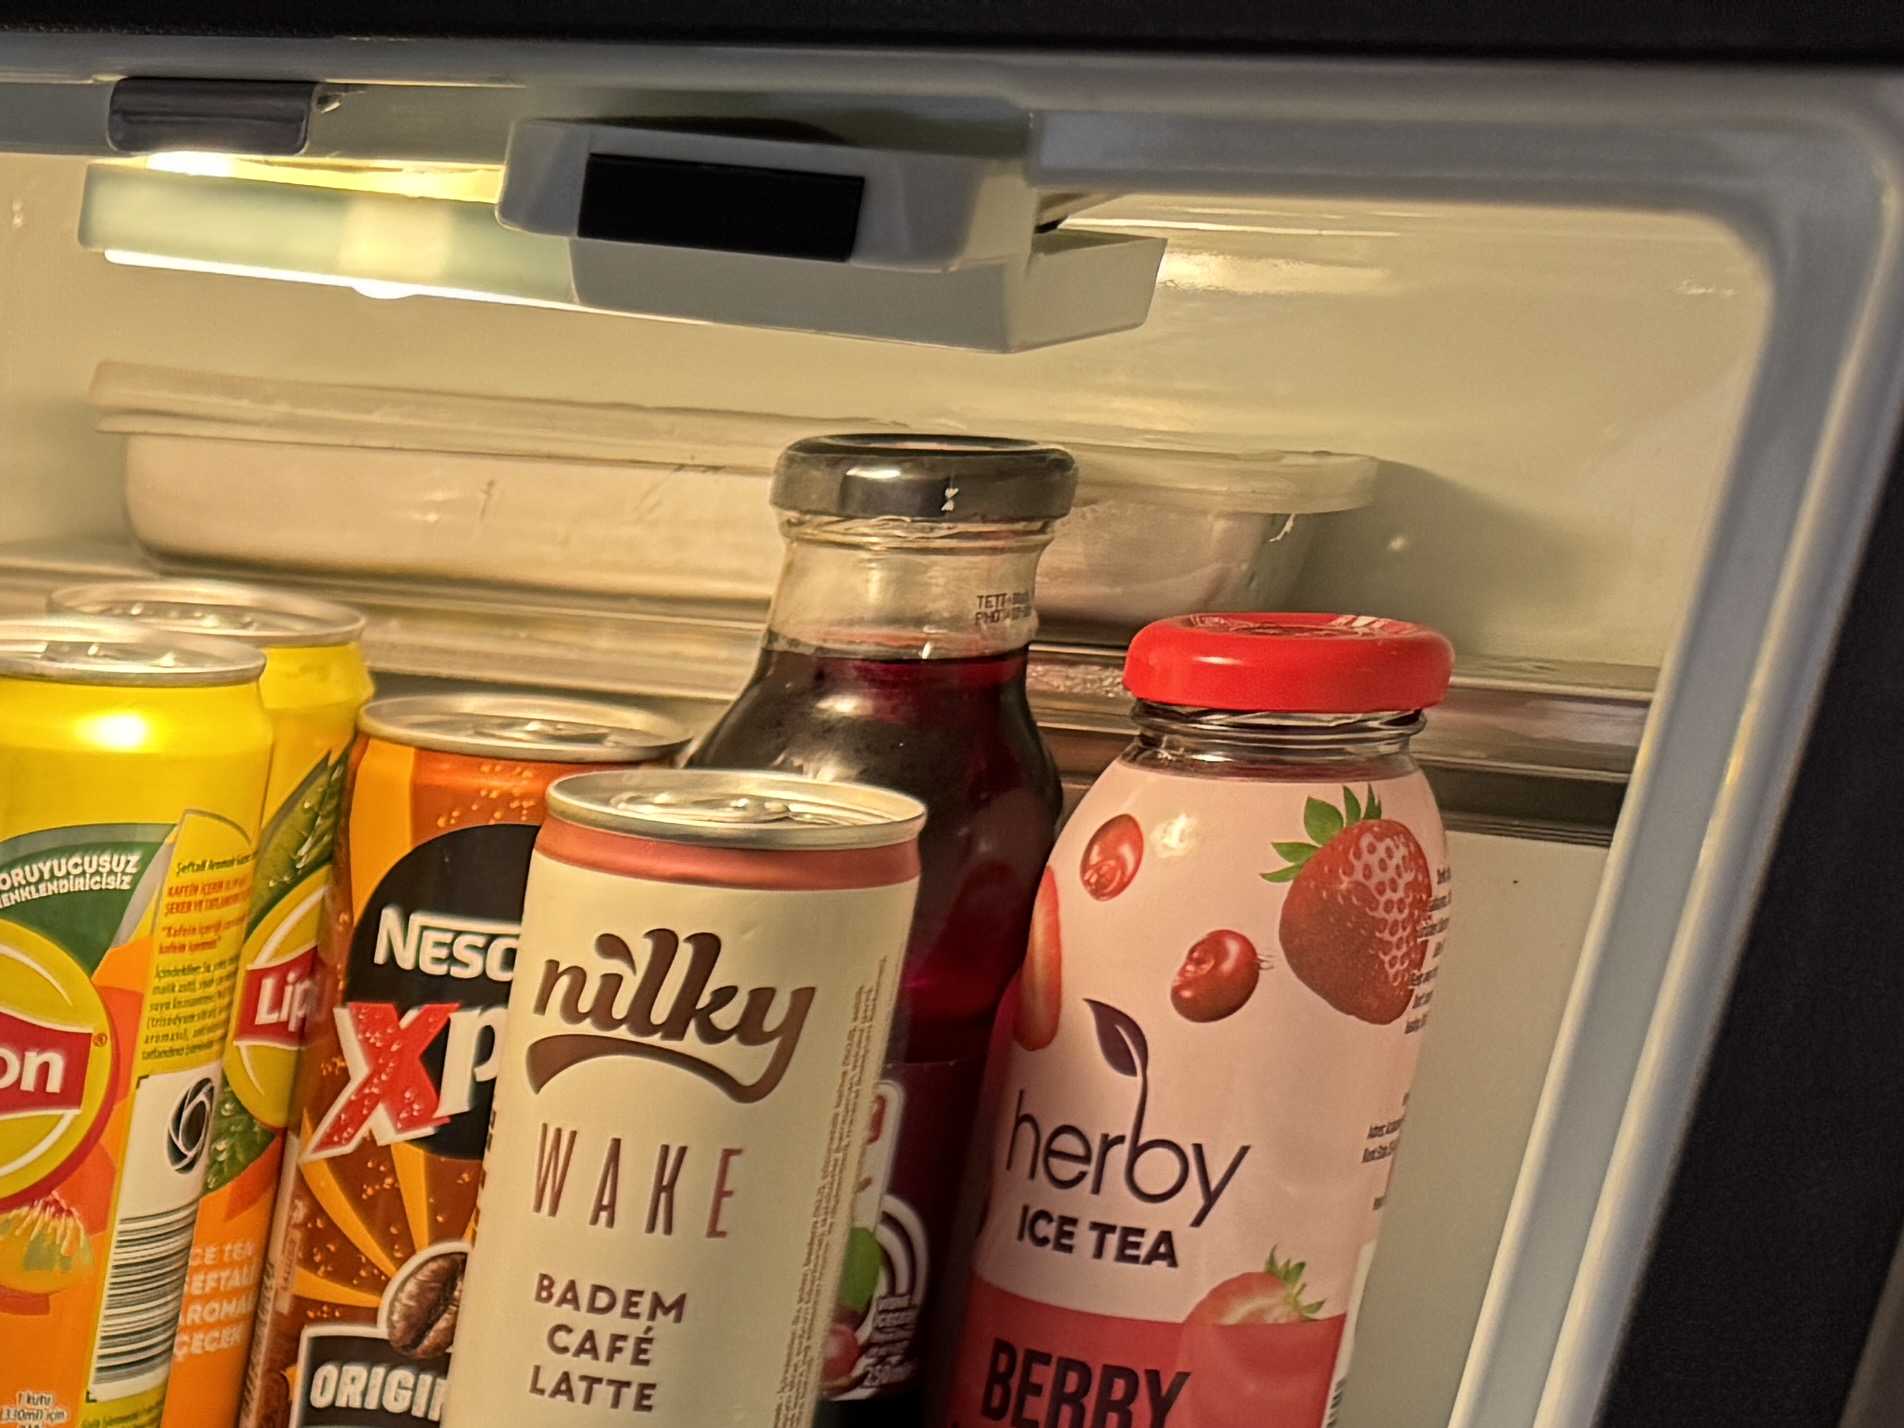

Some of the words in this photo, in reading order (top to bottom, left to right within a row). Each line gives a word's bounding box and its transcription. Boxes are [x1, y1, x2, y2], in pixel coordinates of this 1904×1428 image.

[373, 906, 521, 982] NESC
[254, 968, 319, 1033] Lip
[526, 928, 817, 1105] nilky
[533, 1122, 744, 1239] WAKE
[1005, 1069, 1252, 1228] herby
[189, 1244, 219, 1267] CE
[1017, 1203, 1079, 1255] ICE
[1091, 1220, 1180, 1269] TEA
[534, 1272, 689, 1325] BADEM
[546, 1324, 656, 1368] CAFÉ
[309, 1362, 448, 1422] ORIGI
[528, 1364, 658, 1413] LATTE
